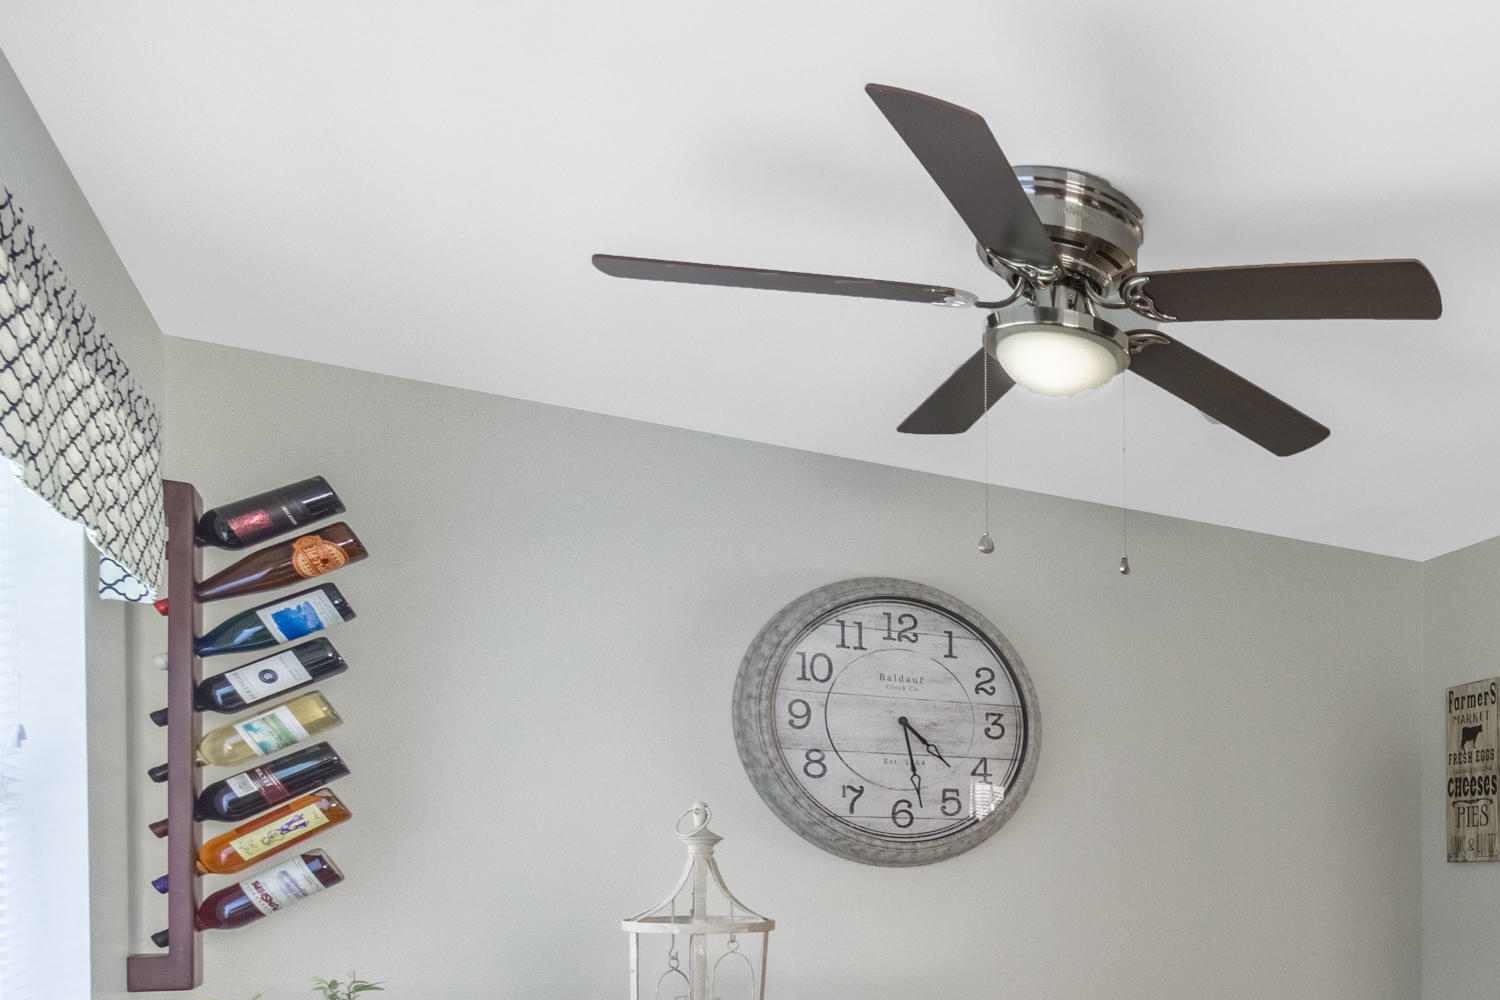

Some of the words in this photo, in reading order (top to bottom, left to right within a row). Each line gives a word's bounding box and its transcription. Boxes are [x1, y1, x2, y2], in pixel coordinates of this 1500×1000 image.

[835, 619, 868, 651] 11
[882, 611, 919, 643] 12
[943, 630, 958, 659] 1
[796, 651, 834, 683] 10
[974, 667, 996, 696] 2
[787, 699, 812, 730] 9
[984, 712, 1006, 740] 3
[803, 749, 828, 779] 8
[970, 757, 993, 785] 4
[1448, 750, 1473, 766] FRESH
[1475, 748, 1495, 762] EGGS
[841, 784, 865, 815] 7
[891, 799, 915, 829] 6
[940, 788, 963, 817] 5
[1456, 804, 1489, 829] PIES
